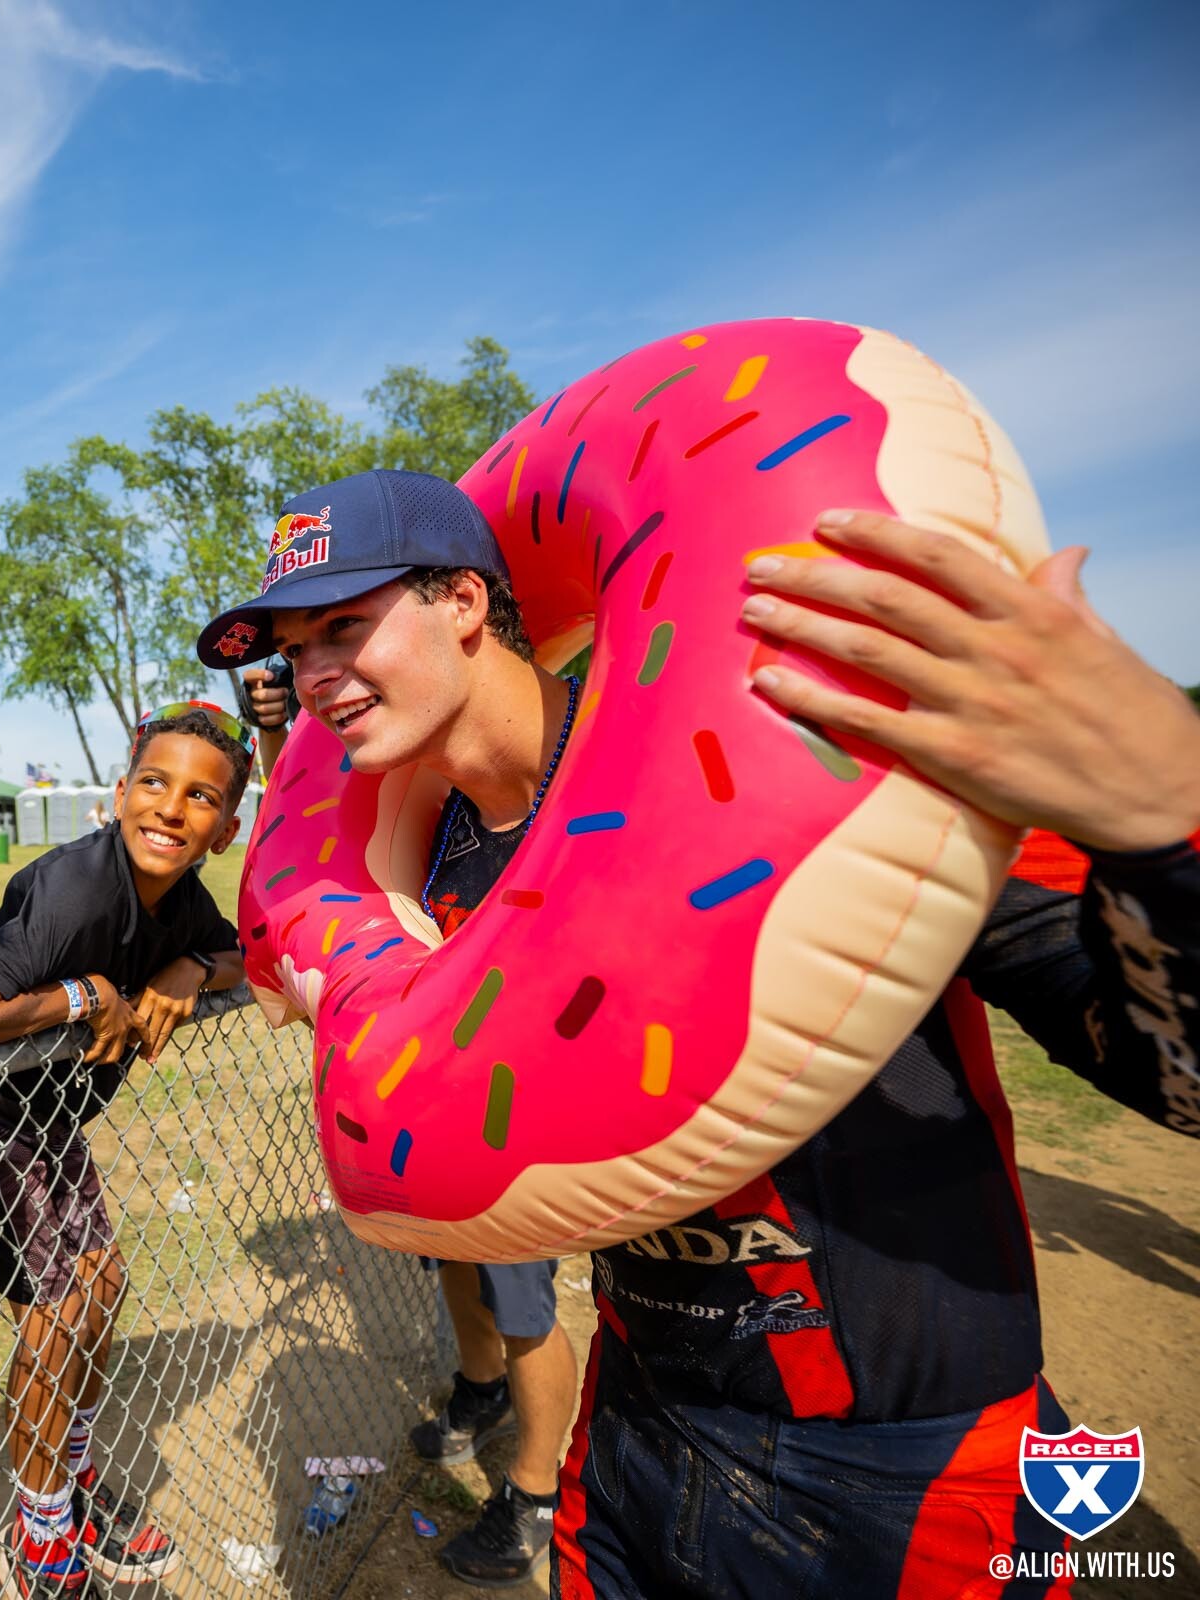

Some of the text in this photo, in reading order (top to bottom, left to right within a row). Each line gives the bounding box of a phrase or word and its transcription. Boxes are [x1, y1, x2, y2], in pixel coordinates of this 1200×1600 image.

[281, 536, 330, 577] Bull
[626, 1219, 812, 1265] NDA
[628, 1291, 725, 1320] DUNLOP
